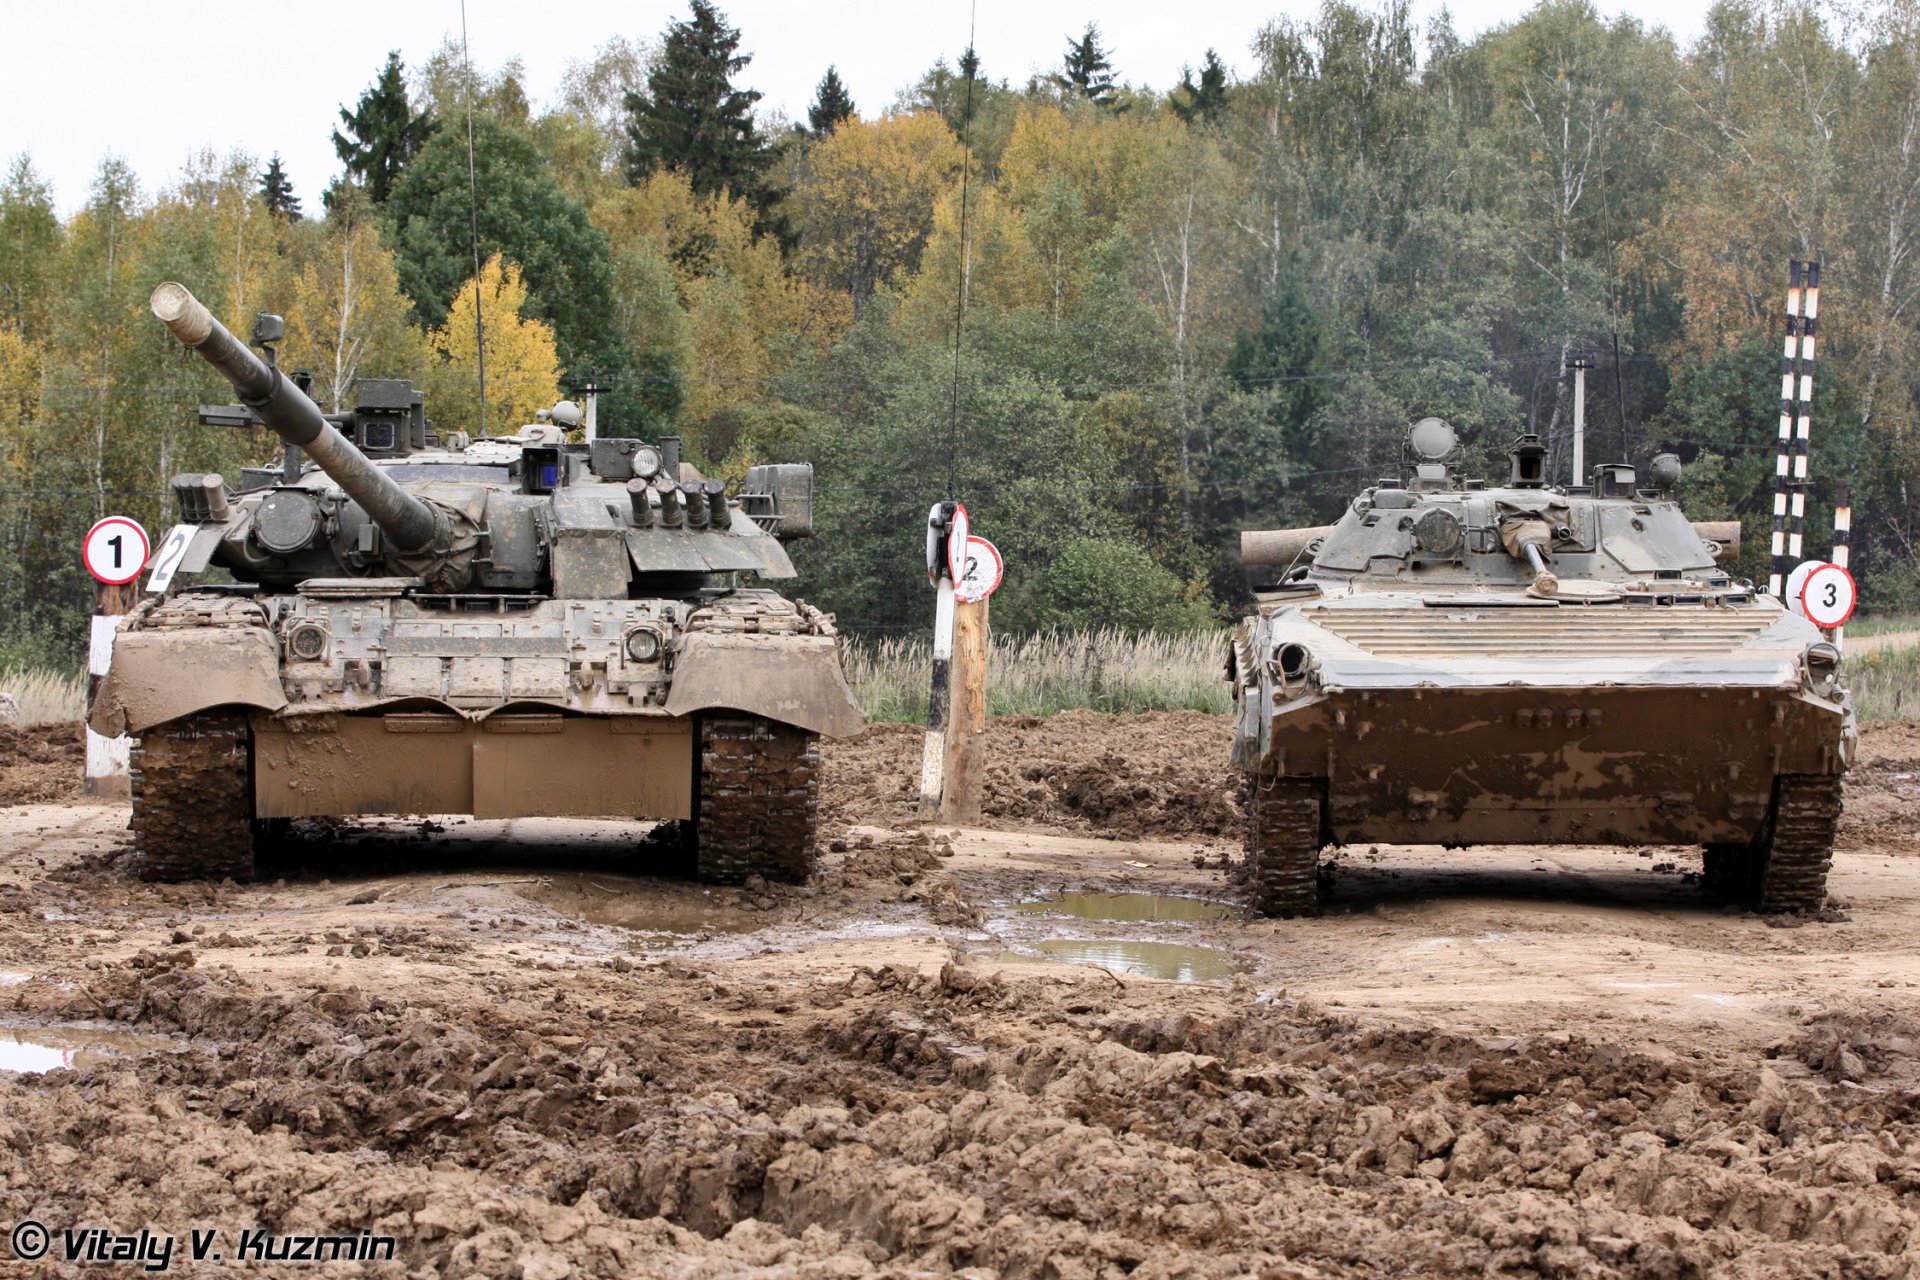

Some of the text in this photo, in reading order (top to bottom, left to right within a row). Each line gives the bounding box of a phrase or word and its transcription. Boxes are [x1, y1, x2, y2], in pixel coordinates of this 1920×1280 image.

[107, 535, 122, 569] 1
[154, 533, 186, 581] 2
[962, 556, 978, 581] 2
[1822, 582, 1837, 608] 3
